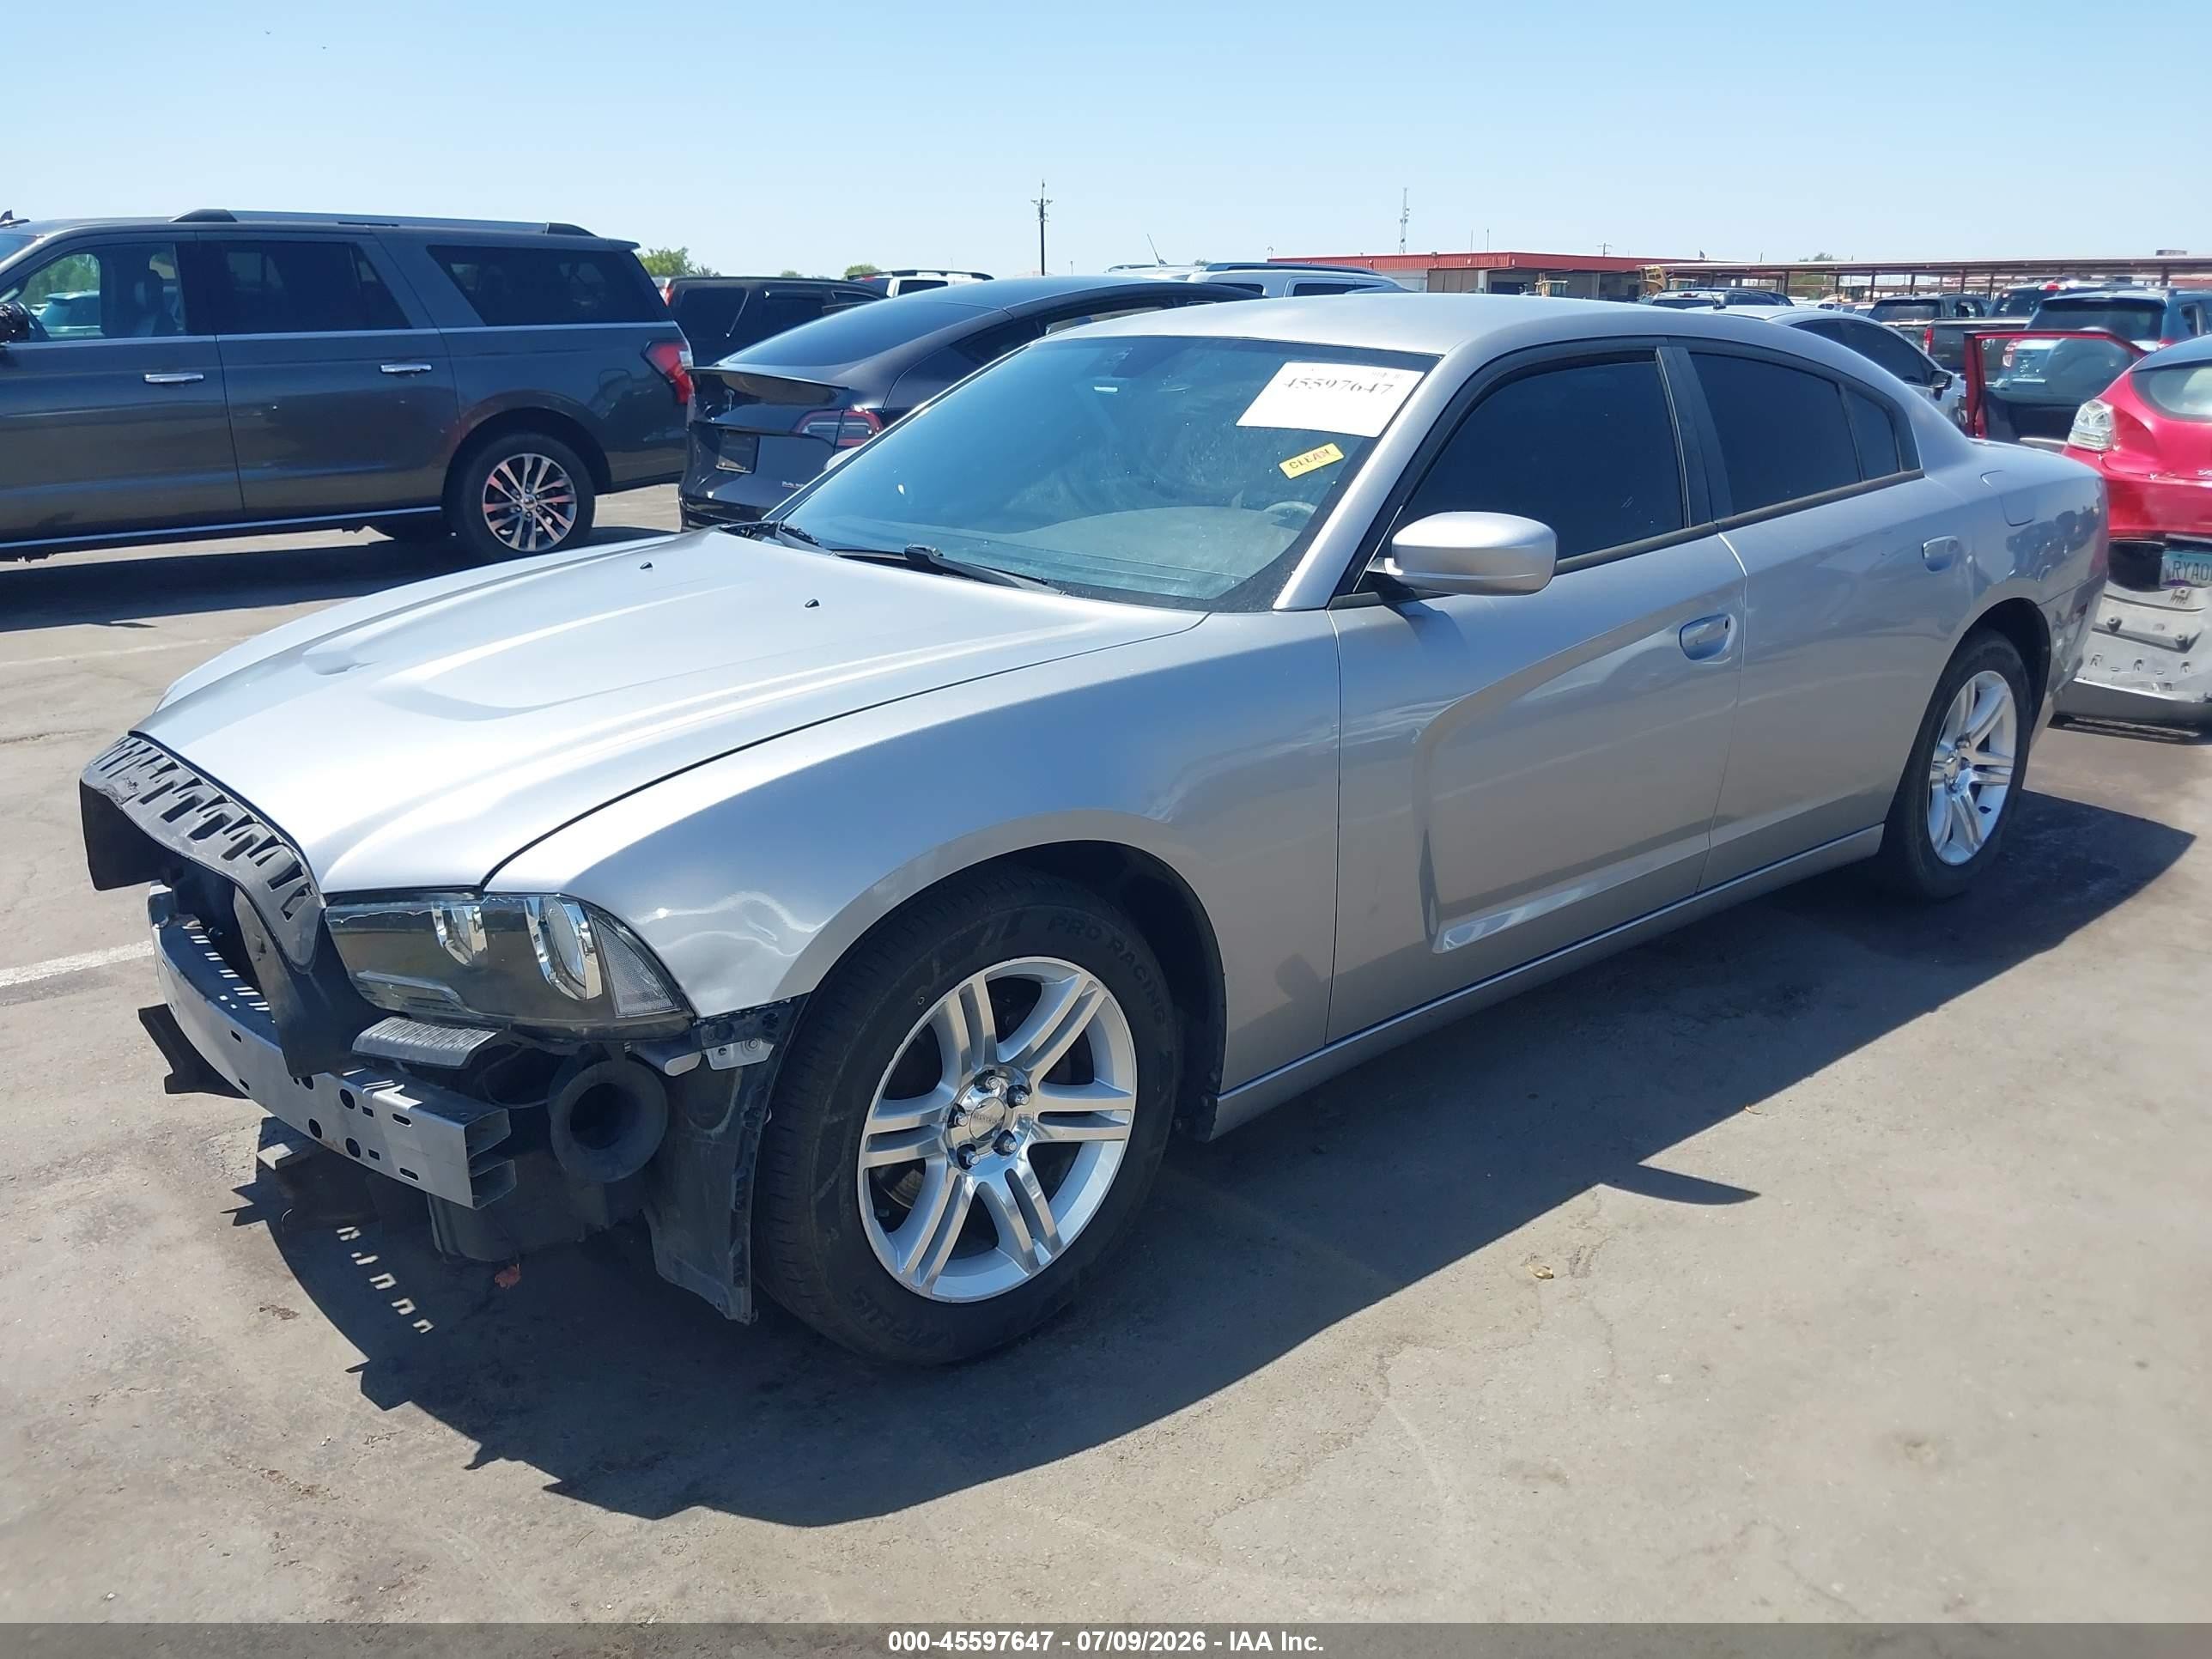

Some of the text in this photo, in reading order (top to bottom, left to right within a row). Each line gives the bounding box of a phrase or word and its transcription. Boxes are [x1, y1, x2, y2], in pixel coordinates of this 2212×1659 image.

[1289, 449, 1330, 469] CLEAN
[1047, 916, 1167, 1025] PRO RACING
